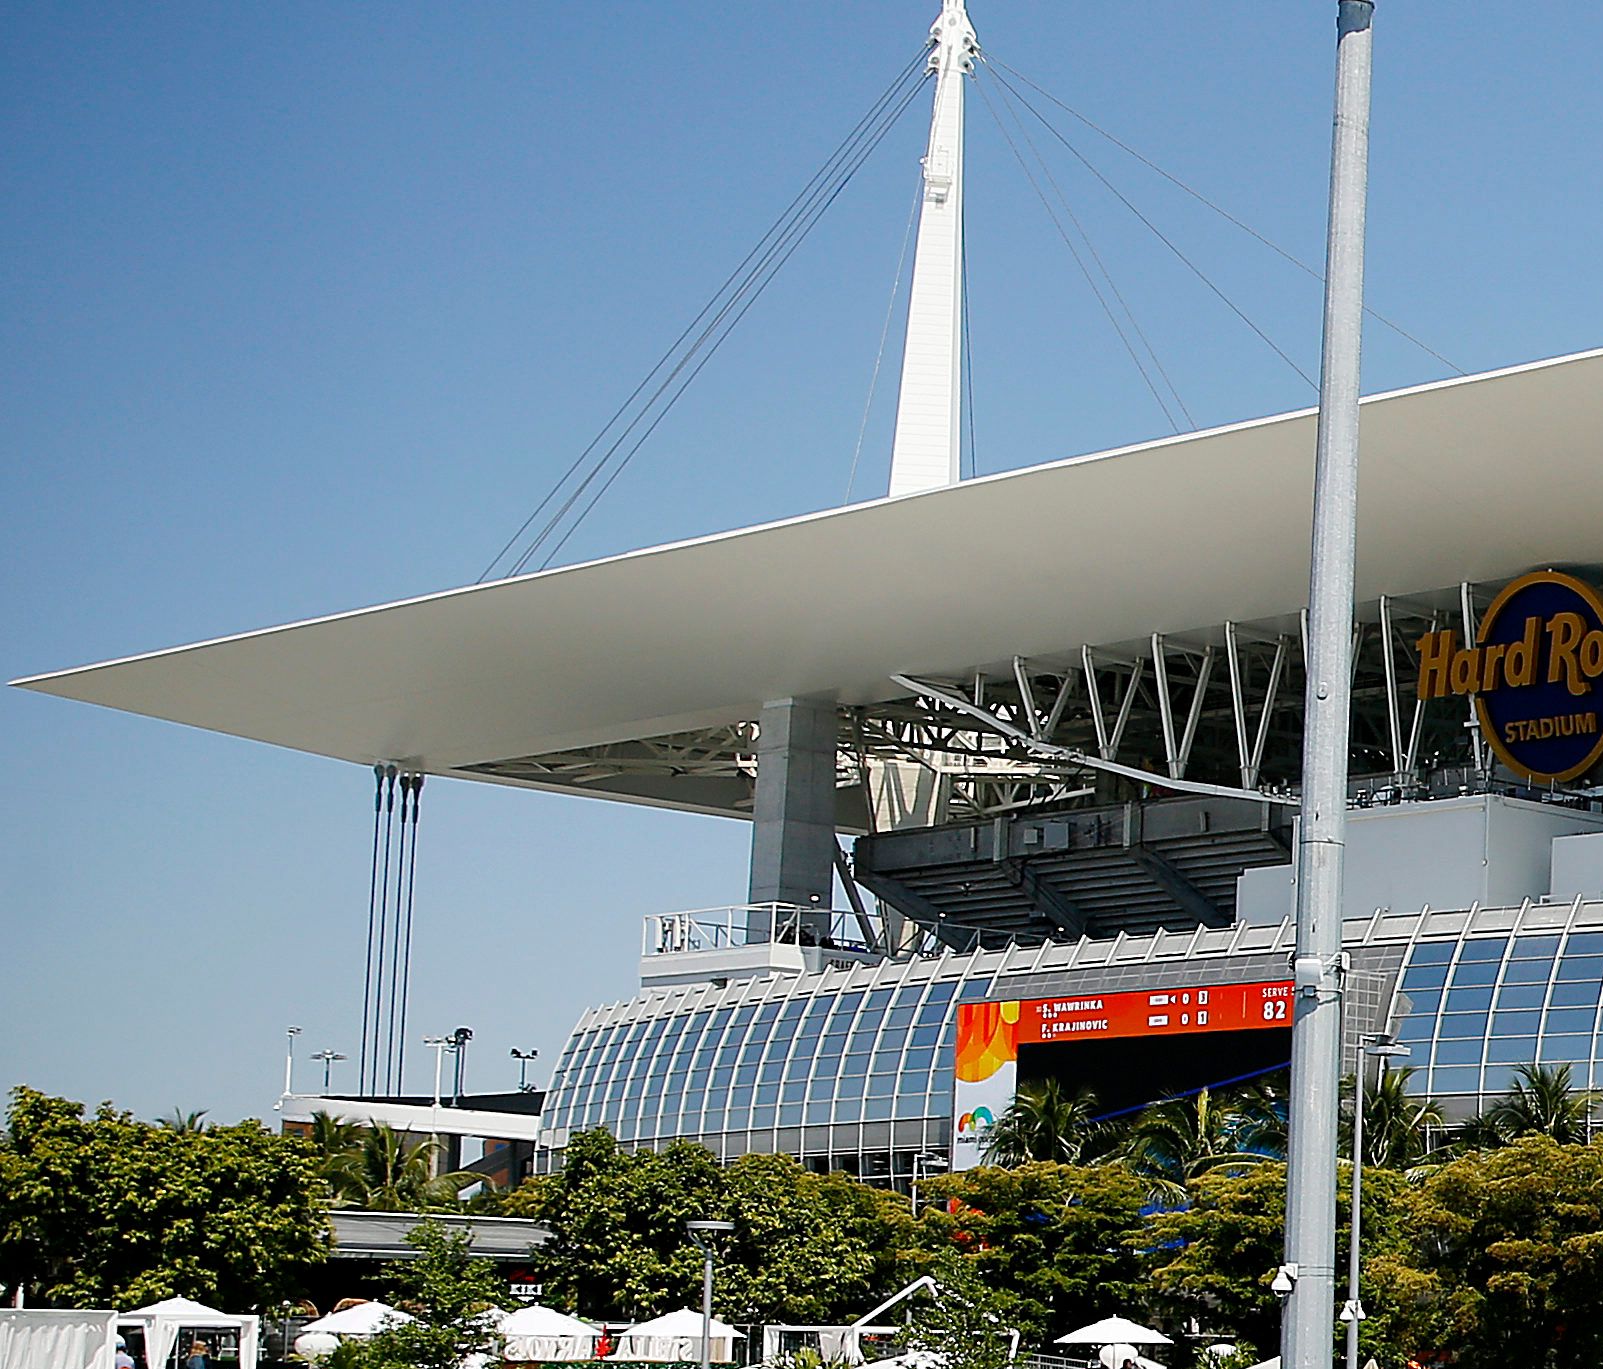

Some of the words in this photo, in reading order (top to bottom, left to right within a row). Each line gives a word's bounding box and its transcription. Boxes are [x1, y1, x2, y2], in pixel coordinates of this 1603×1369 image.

[1416, 615, 1541, 700] Hard
[1505, 712, 1597, 743] STADIUM
[1262, 987, 1288, 998] SERVE
[1053, 999, 1104, 1013] WAWRINKA
[1263, 1000, 1286, 1020] 82
[509, 1283, 543, 1295] KIKI
